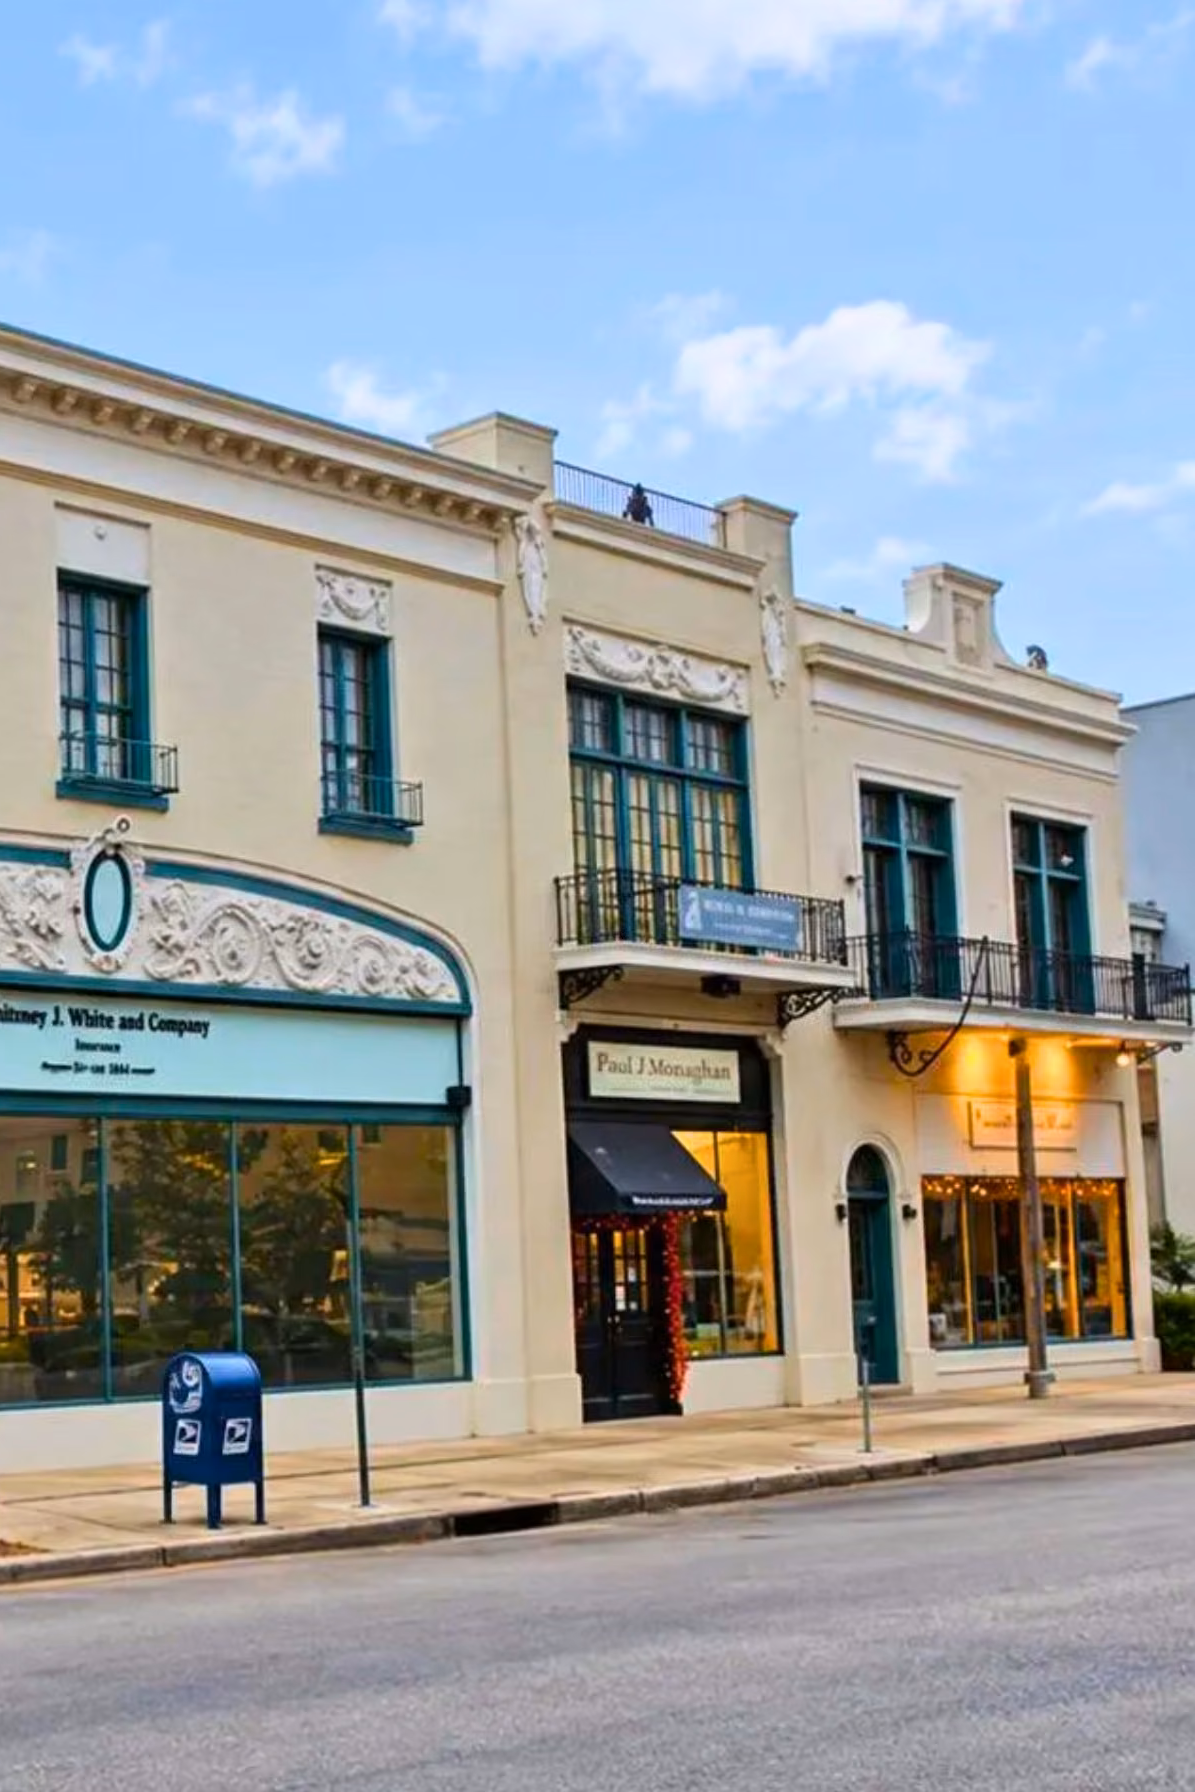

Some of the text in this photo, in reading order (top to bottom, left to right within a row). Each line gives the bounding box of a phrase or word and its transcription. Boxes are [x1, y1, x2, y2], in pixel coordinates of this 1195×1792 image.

[52, 1005, 64, 1027] J.
[67, 1007, 115, 1030] White
[118, 1011, 145, 1032] and
[148, 1012, 210, 1039] Company
[596, 1051, 732, 1086] Paul J Monaghan
